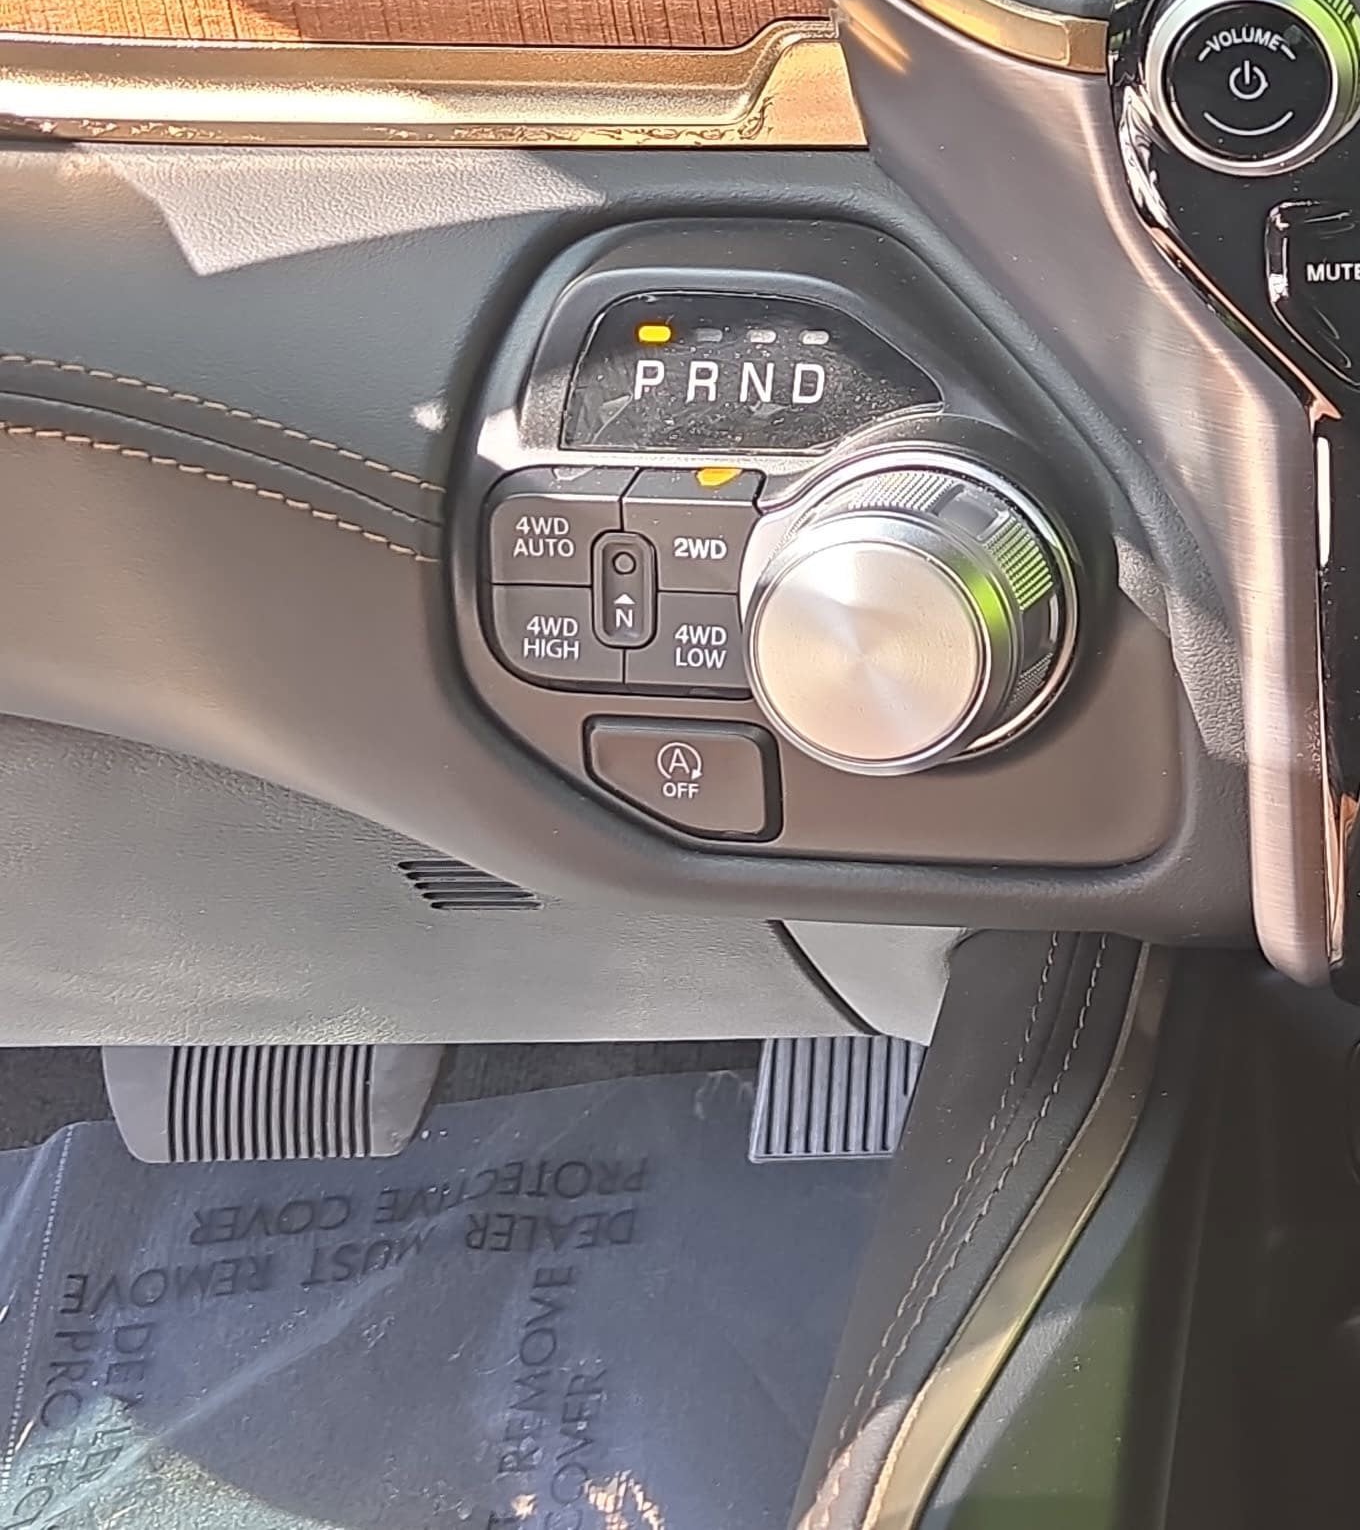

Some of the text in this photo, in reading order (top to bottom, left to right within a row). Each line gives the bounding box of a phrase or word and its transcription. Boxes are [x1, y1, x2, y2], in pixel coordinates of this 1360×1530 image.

[1206, 26, 1283, 53] VOLUME
[516, 517, 569, 536] 4WD
[512, 537, 574, 557] AUTO
[674, 538, 727, 559] 2WD
[527, 617, 579, 636] 4WD
[615, 609, 633, 628] N
[674, 624, 727, 646] 4WD
[524, 638, 580, 660] HIGH
[675, 647, 726, 668] LOW
[663, 780, 698, 798] OFF
[190, 1195, 351, 1245] COVER
[465, 1208, 637, 1251] DEALER
[59, 1256, 272, 1315] REMOVE
